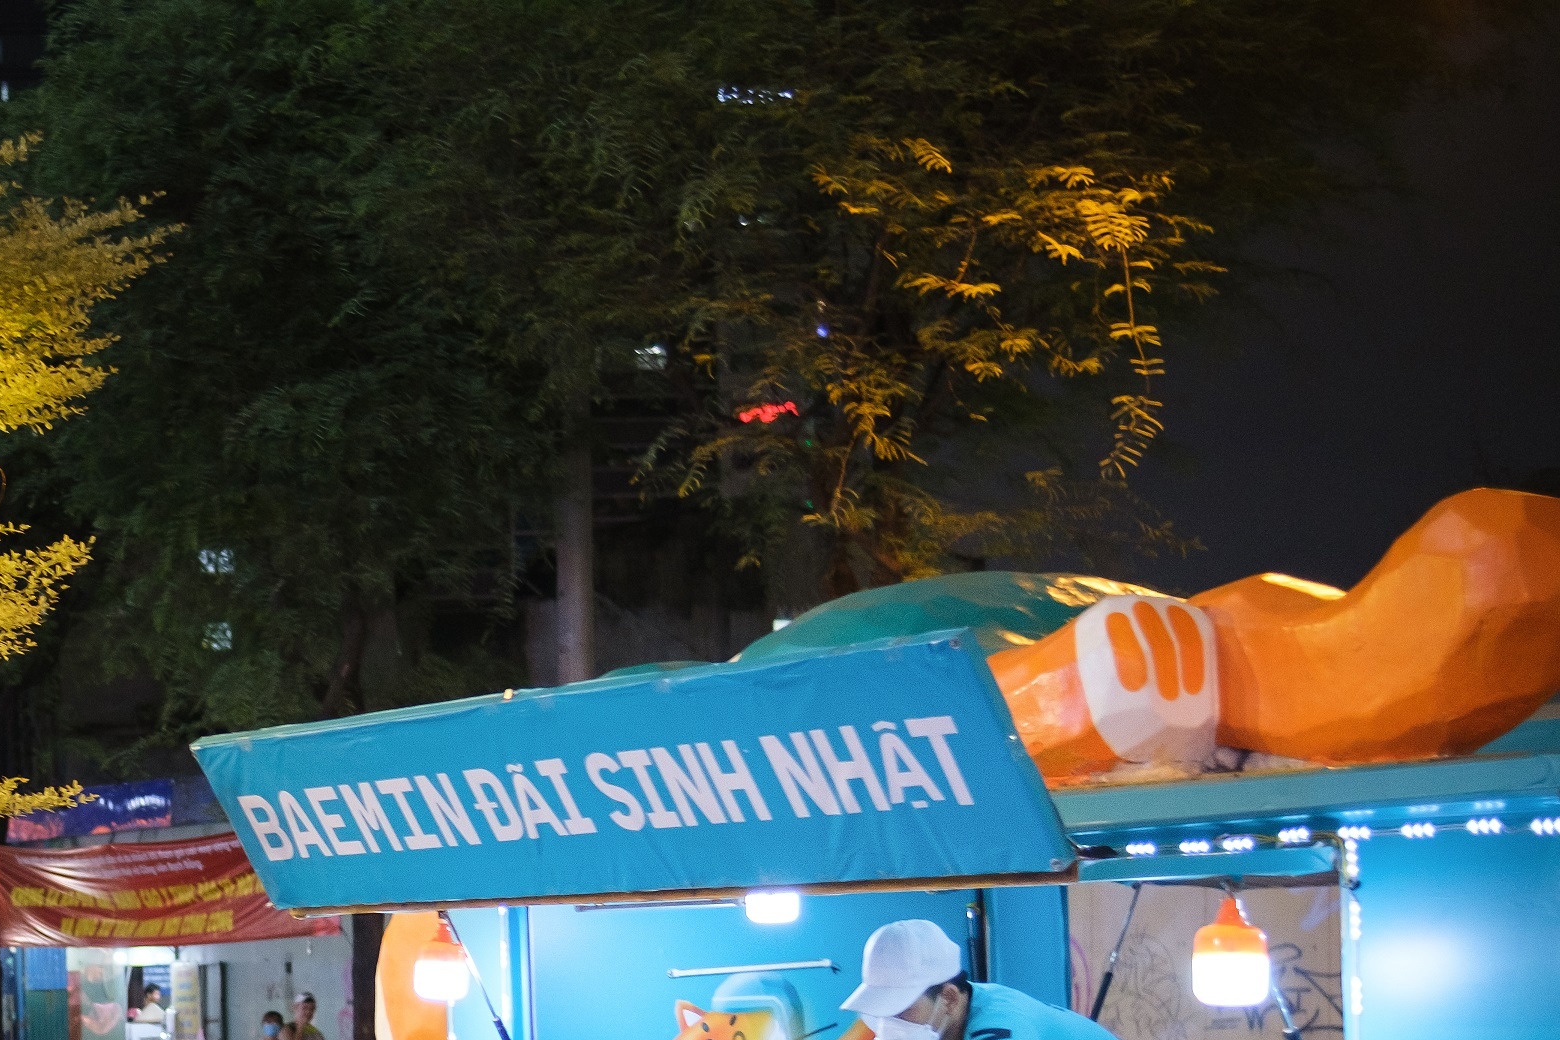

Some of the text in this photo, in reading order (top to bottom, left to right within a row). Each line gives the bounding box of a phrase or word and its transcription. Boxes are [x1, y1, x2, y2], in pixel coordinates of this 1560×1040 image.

[237, 715, 975, 861] BAEMIN ĐÃI SINH NHẬT
